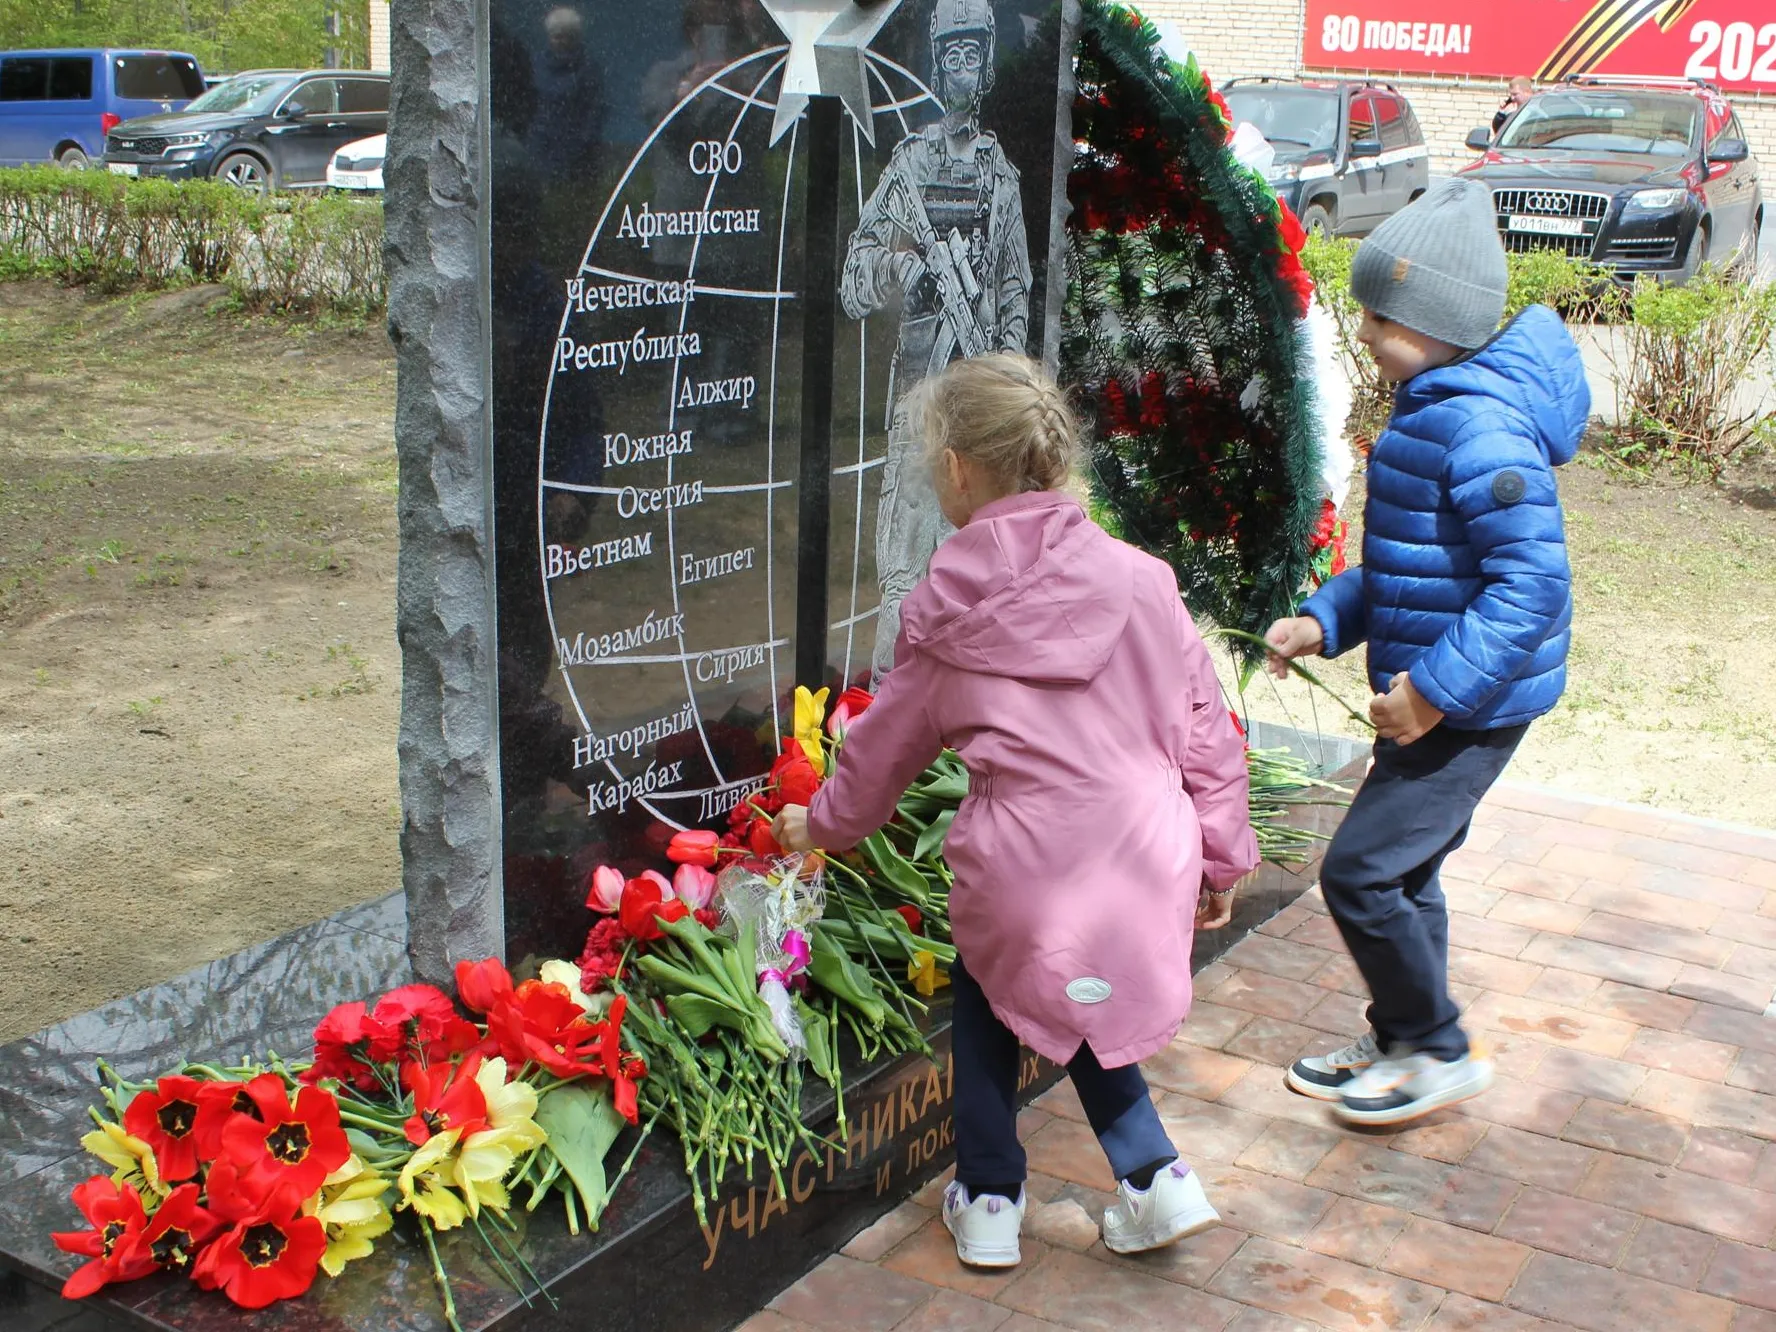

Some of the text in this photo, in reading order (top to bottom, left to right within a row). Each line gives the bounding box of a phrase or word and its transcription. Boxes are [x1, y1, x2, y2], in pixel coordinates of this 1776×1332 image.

[1322, 14, 1472, 57] 80 ПОБЕДА!
[688, 141, 742, 175] СВО
[616, 202, 760, 248] Афганистан
[565, 278, 695, 312] Чеченская
[557, 326, 701, 375] Республика
[677, 375, 755, 409] Алжир
[603, 430, 693, 468] Южная
[617, 479, 703, 518] Осетия
[546, 532, 652, 579] Вьетнам
[680, 547, 755, 585] Египет
[558, 609, 685, 670] Мозамбик
[696, 643, 765, 684] Сирия
[572, 703, 694, 769] Нагорный
[587, 759, 683, 816] Карабах
[702, 1051, 954, 1271] УЧАСТНИКА
[876, 1160, 890, 1196] И
